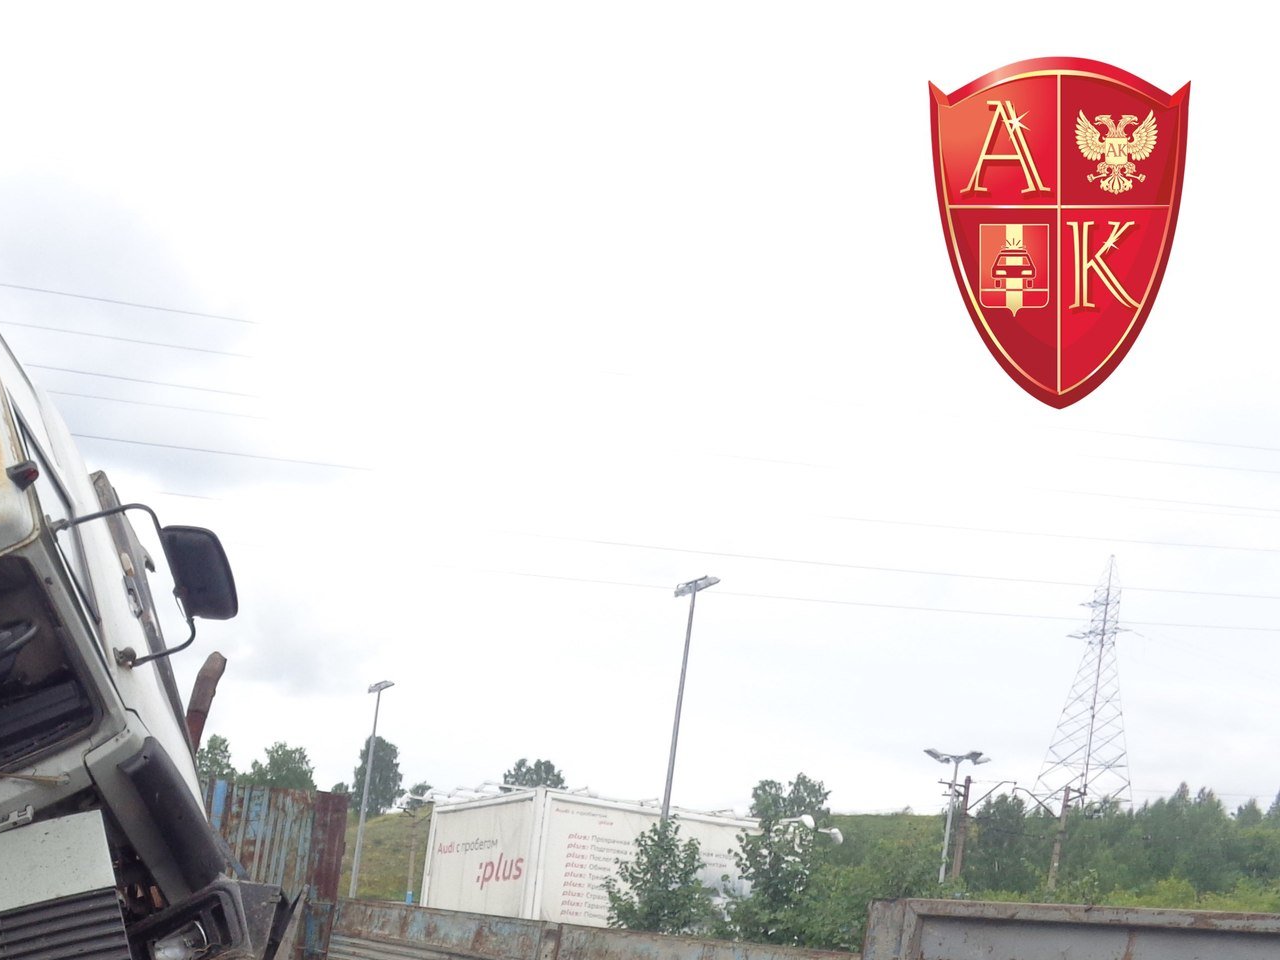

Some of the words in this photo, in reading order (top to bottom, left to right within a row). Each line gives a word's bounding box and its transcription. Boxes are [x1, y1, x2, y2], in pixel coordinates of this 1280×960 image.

[437, 842, 455, 854] Audi
[461, 837, 498, 854] пробегом
[476, 852, 524, 891] :plus
